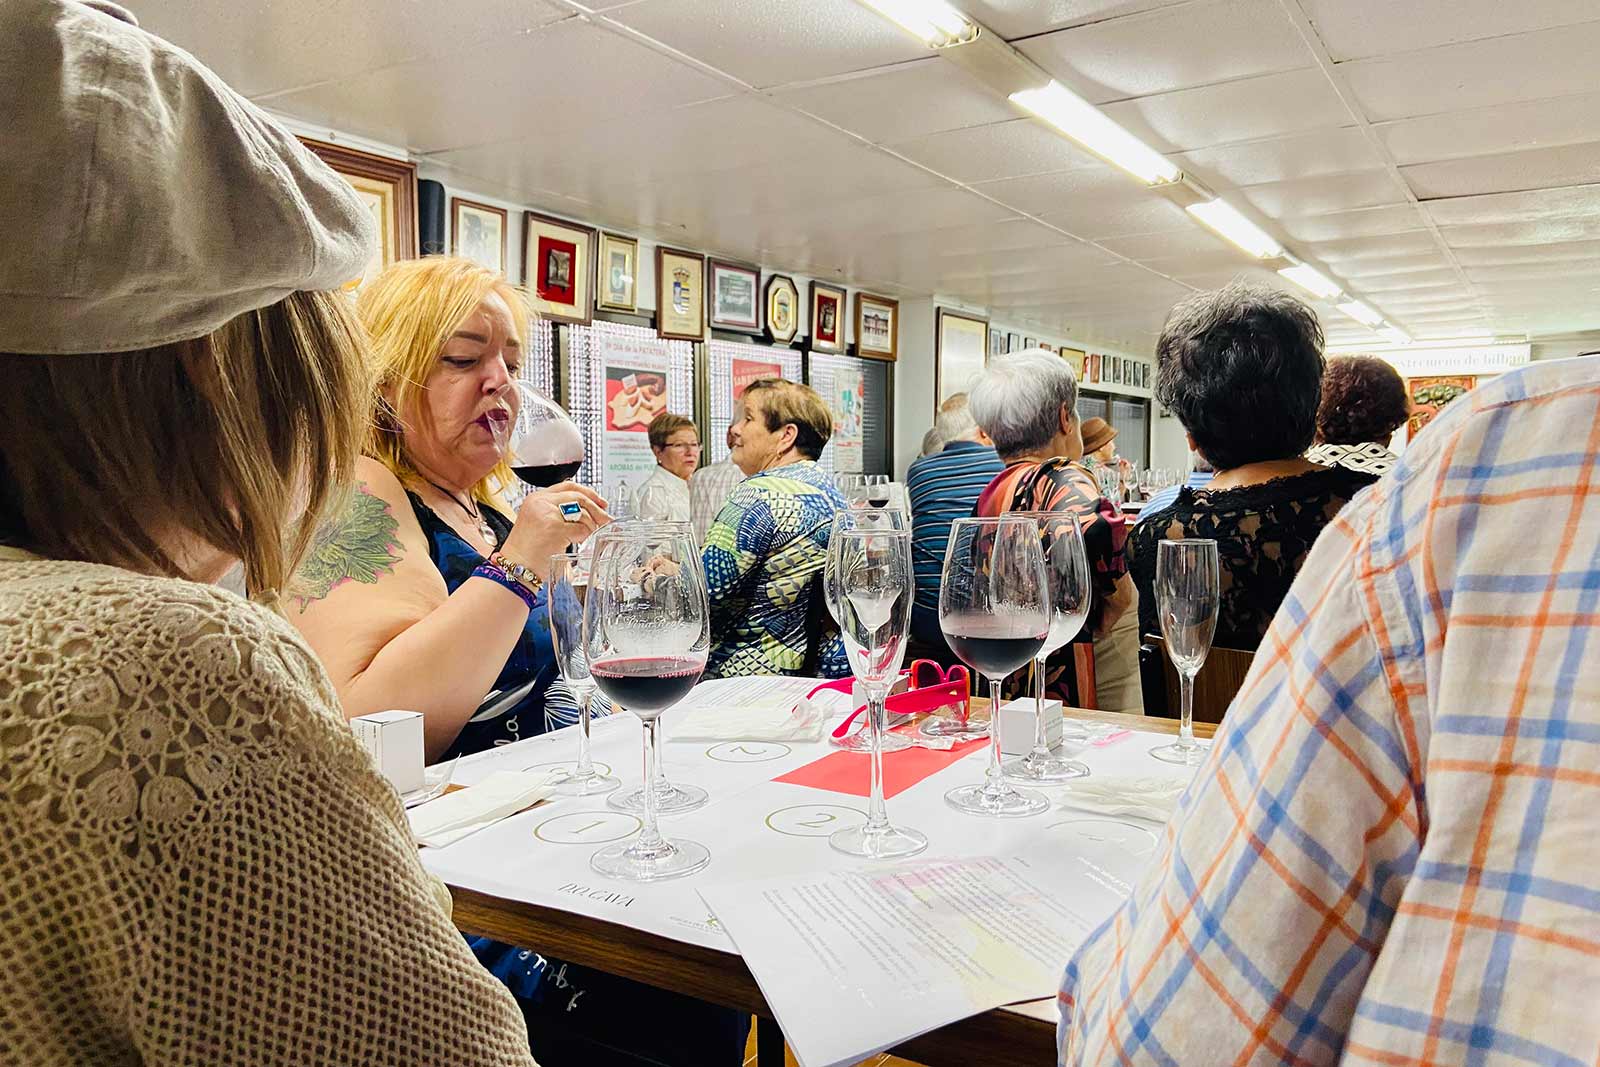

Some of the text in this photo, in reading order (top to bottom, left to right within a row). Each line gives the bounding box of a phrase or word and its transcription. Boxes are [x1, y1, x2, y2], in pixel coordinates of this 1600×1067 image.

[568, 819, 608, 834] 1
[796, 811, 837, 829] 2
[588, 890, 636, 908] CAVA
